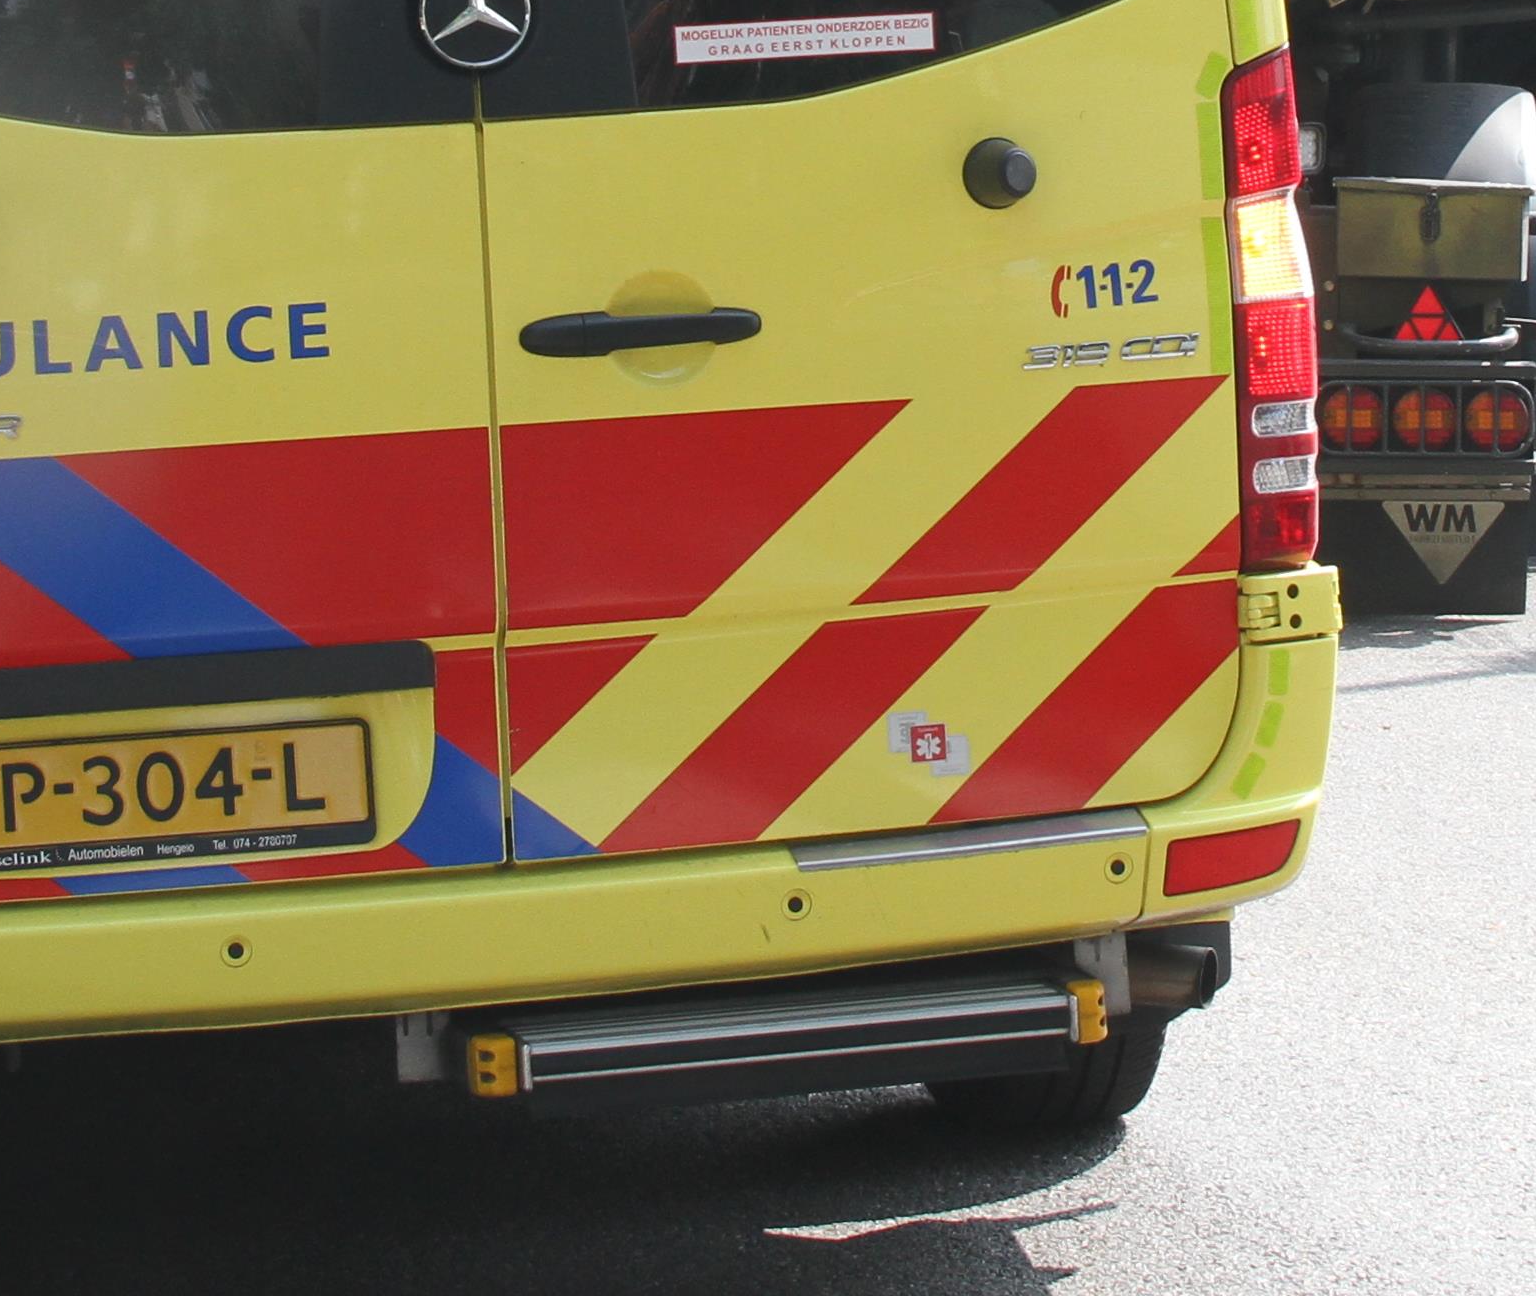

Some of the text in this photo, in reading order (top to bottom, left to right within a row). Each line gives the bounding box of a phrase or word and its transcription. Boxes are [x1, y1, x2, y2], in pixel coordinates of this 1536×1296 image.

[681, 18, 929, 42] MOGELIJK PATIENTEN ONDERZOEK BEZIG
[708, 35, 906, 56] GRAAG EERST KLOPPEN
[1076, 258, 1159, 309] 1-1-2
[1022, 332, 1200, 371] 319 CDI
[1403, 504, 1476, 533] WM
[68, 844, 144, 862] Automobielen
[213, 839, 228, 850] Tel.
